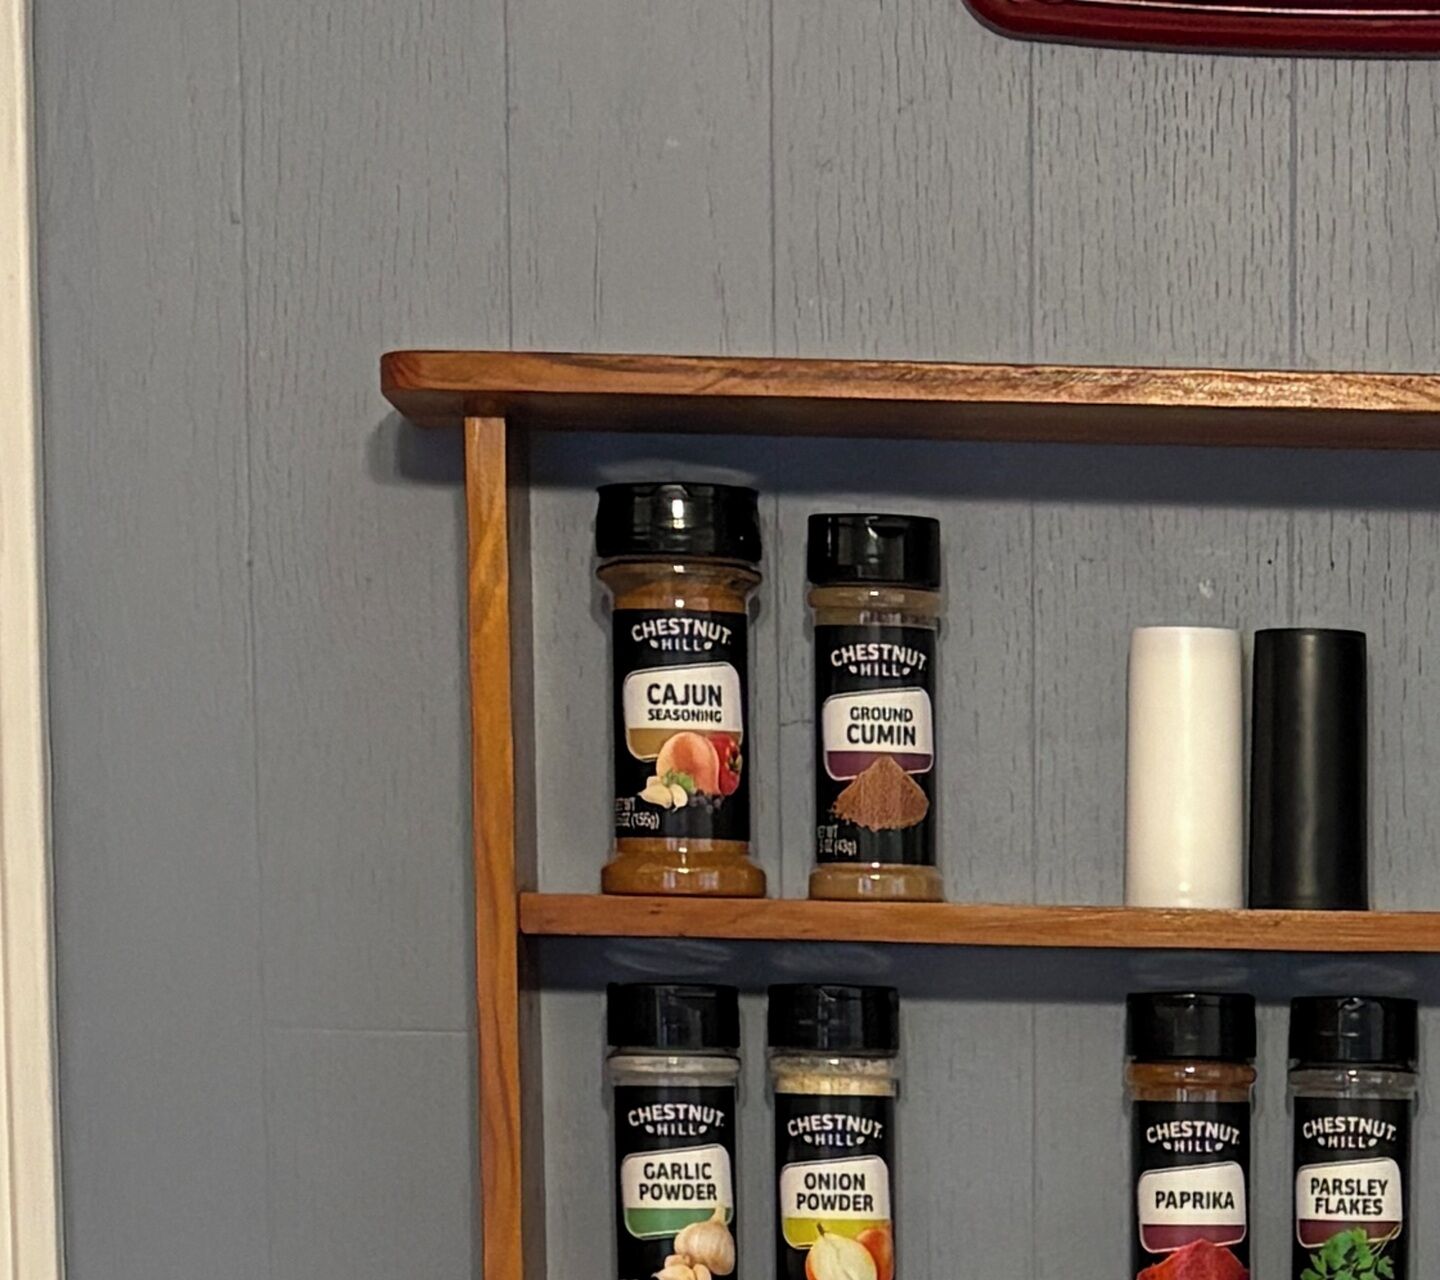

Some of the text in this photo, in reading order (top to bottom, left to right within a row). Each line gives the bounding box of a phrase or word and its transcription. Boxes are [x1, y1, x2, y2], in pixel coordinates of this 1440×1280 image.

[631, 618, 732, 644] CHESTNUT
[662, 636, 701, 651] HILL
[831, 643, 927, 670] CHESTNUT
[861, 663, 899, 677] HILL
[647, 683, 722, 707] CAJUN
[648, 709, 722, 723] SEASONING
[850, 706, 913, 723] GROUND
[847, 724, 916, 746] CUMIN
[628, 1103, 725, 1127] CHESTNUT
[657, 1123, 696, 1136] HILL
[787, 1113, 883, 1139] CHESTNUT
[1146, 1120, 1240, 1144] CHESTNUT
[1303, 1116, 1397, 1141] CHESTNUT
[815, 1133, 854, 1146] HILL
[1174, 1139, 1213, 1152] HILL
[1328, 1136, 1366, 1149] HILL
[643, 1162, 713, 1181] GARLIC
[804, 1172, 866, 1191] ONION
[1310, 1177, 1388, 1196] PARSLEY
[639, 1183, 718, 1201] POWDER
[1155, 1190, 1235, 1210] PAPRIKA
[796, 1193, 874, 1212] POWDER
[1314, 1197, 1383, 1216] FLAKES
